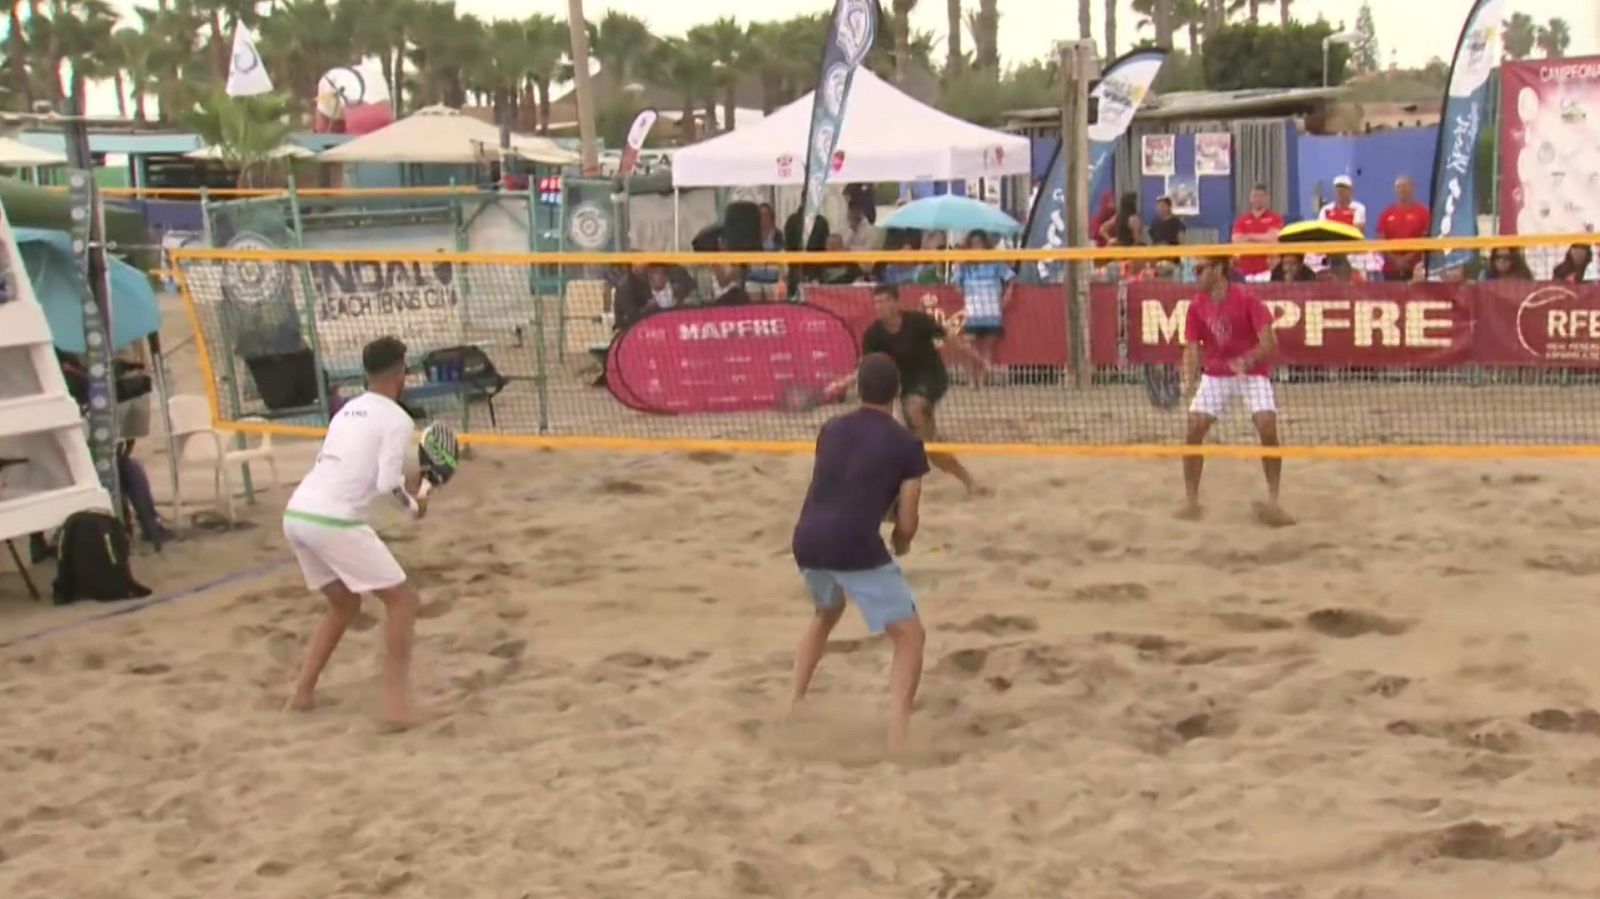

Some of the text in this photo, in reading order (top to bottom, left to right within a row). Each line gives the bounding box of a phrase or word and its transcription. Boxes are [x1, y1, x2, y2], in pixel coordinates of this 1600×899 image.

[679, 317, 786, 341] MAPFRE
[1141, 299, 1453, 348] MPFRE
[1548, 309, 1600, 338] RFE
